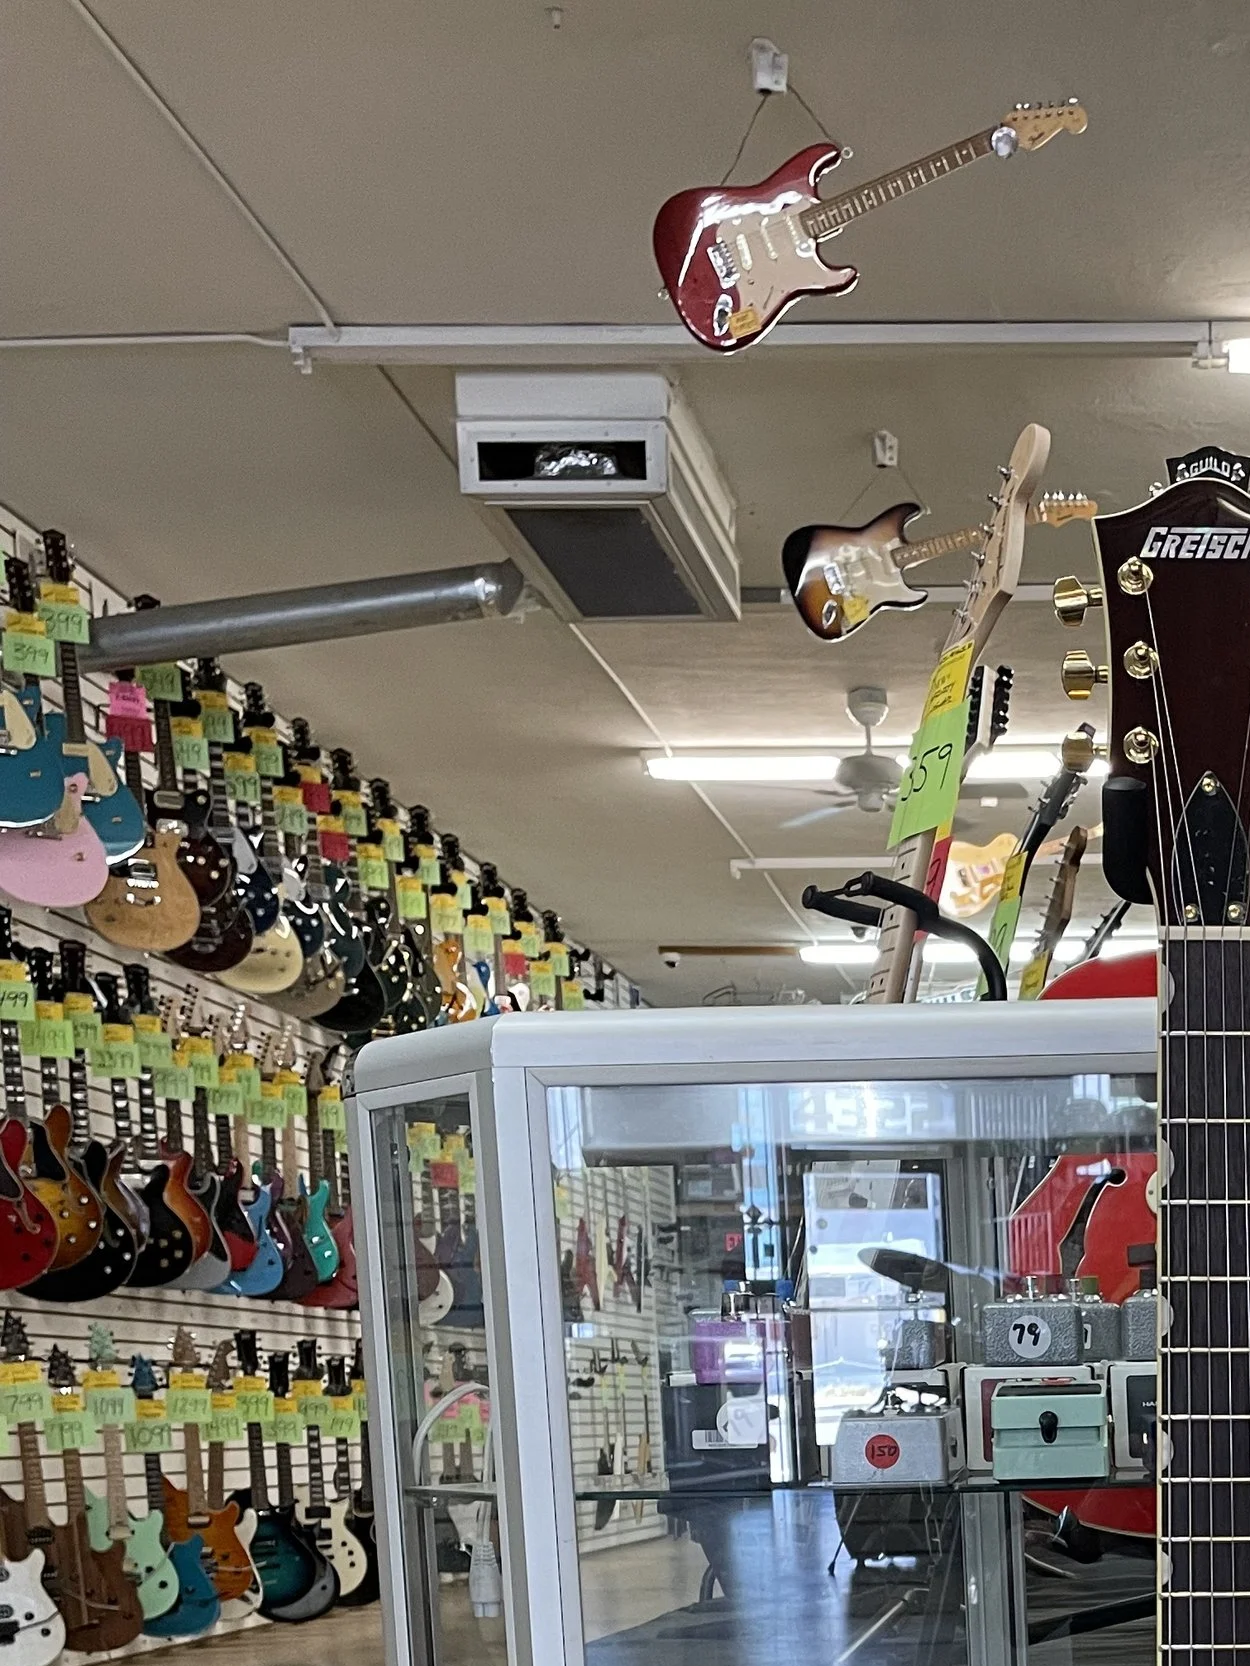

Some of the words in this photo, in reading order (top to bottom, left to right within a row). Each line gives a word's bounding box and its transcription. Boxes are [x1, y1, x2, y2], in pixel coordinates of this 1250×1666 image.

[1189, 455, 1231, 478] GUILD
[1012, 1322, 1041, 1346] 79
[870, 1443, 898, 1460] 150
